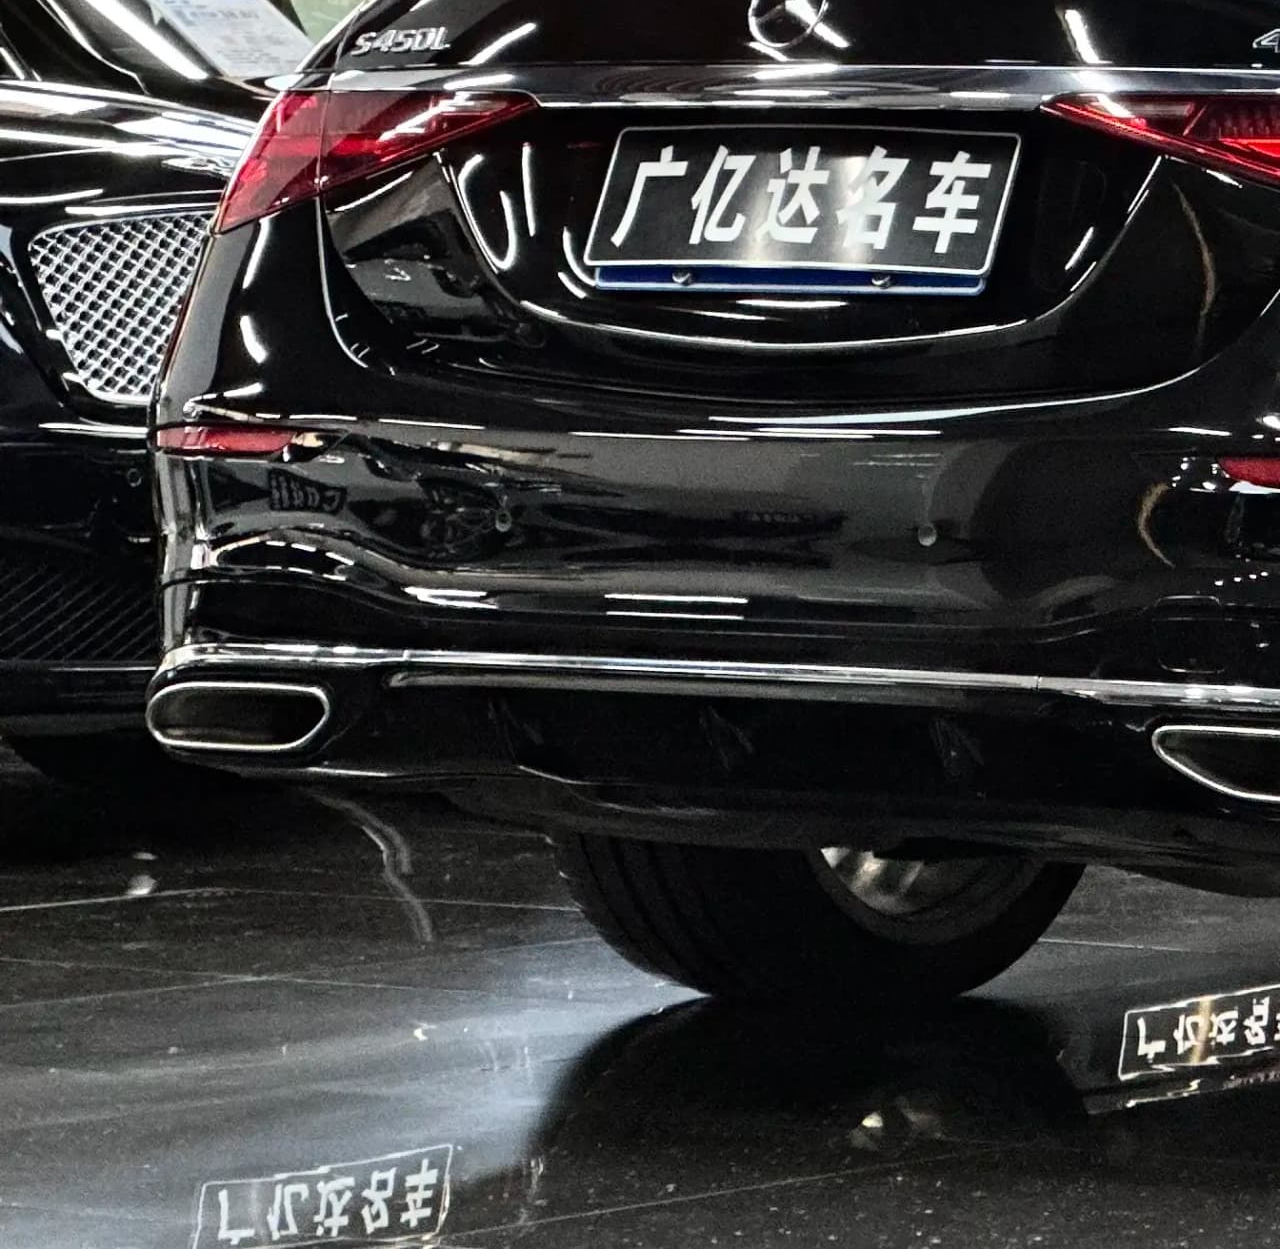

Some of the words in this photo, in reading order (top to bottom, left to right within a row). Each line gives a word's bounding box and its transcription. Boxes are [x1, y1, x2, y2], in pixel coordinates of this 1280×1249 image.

[350, 26, 451, 56] S450L
[609, 145, 993, 254] 广亿达名车
